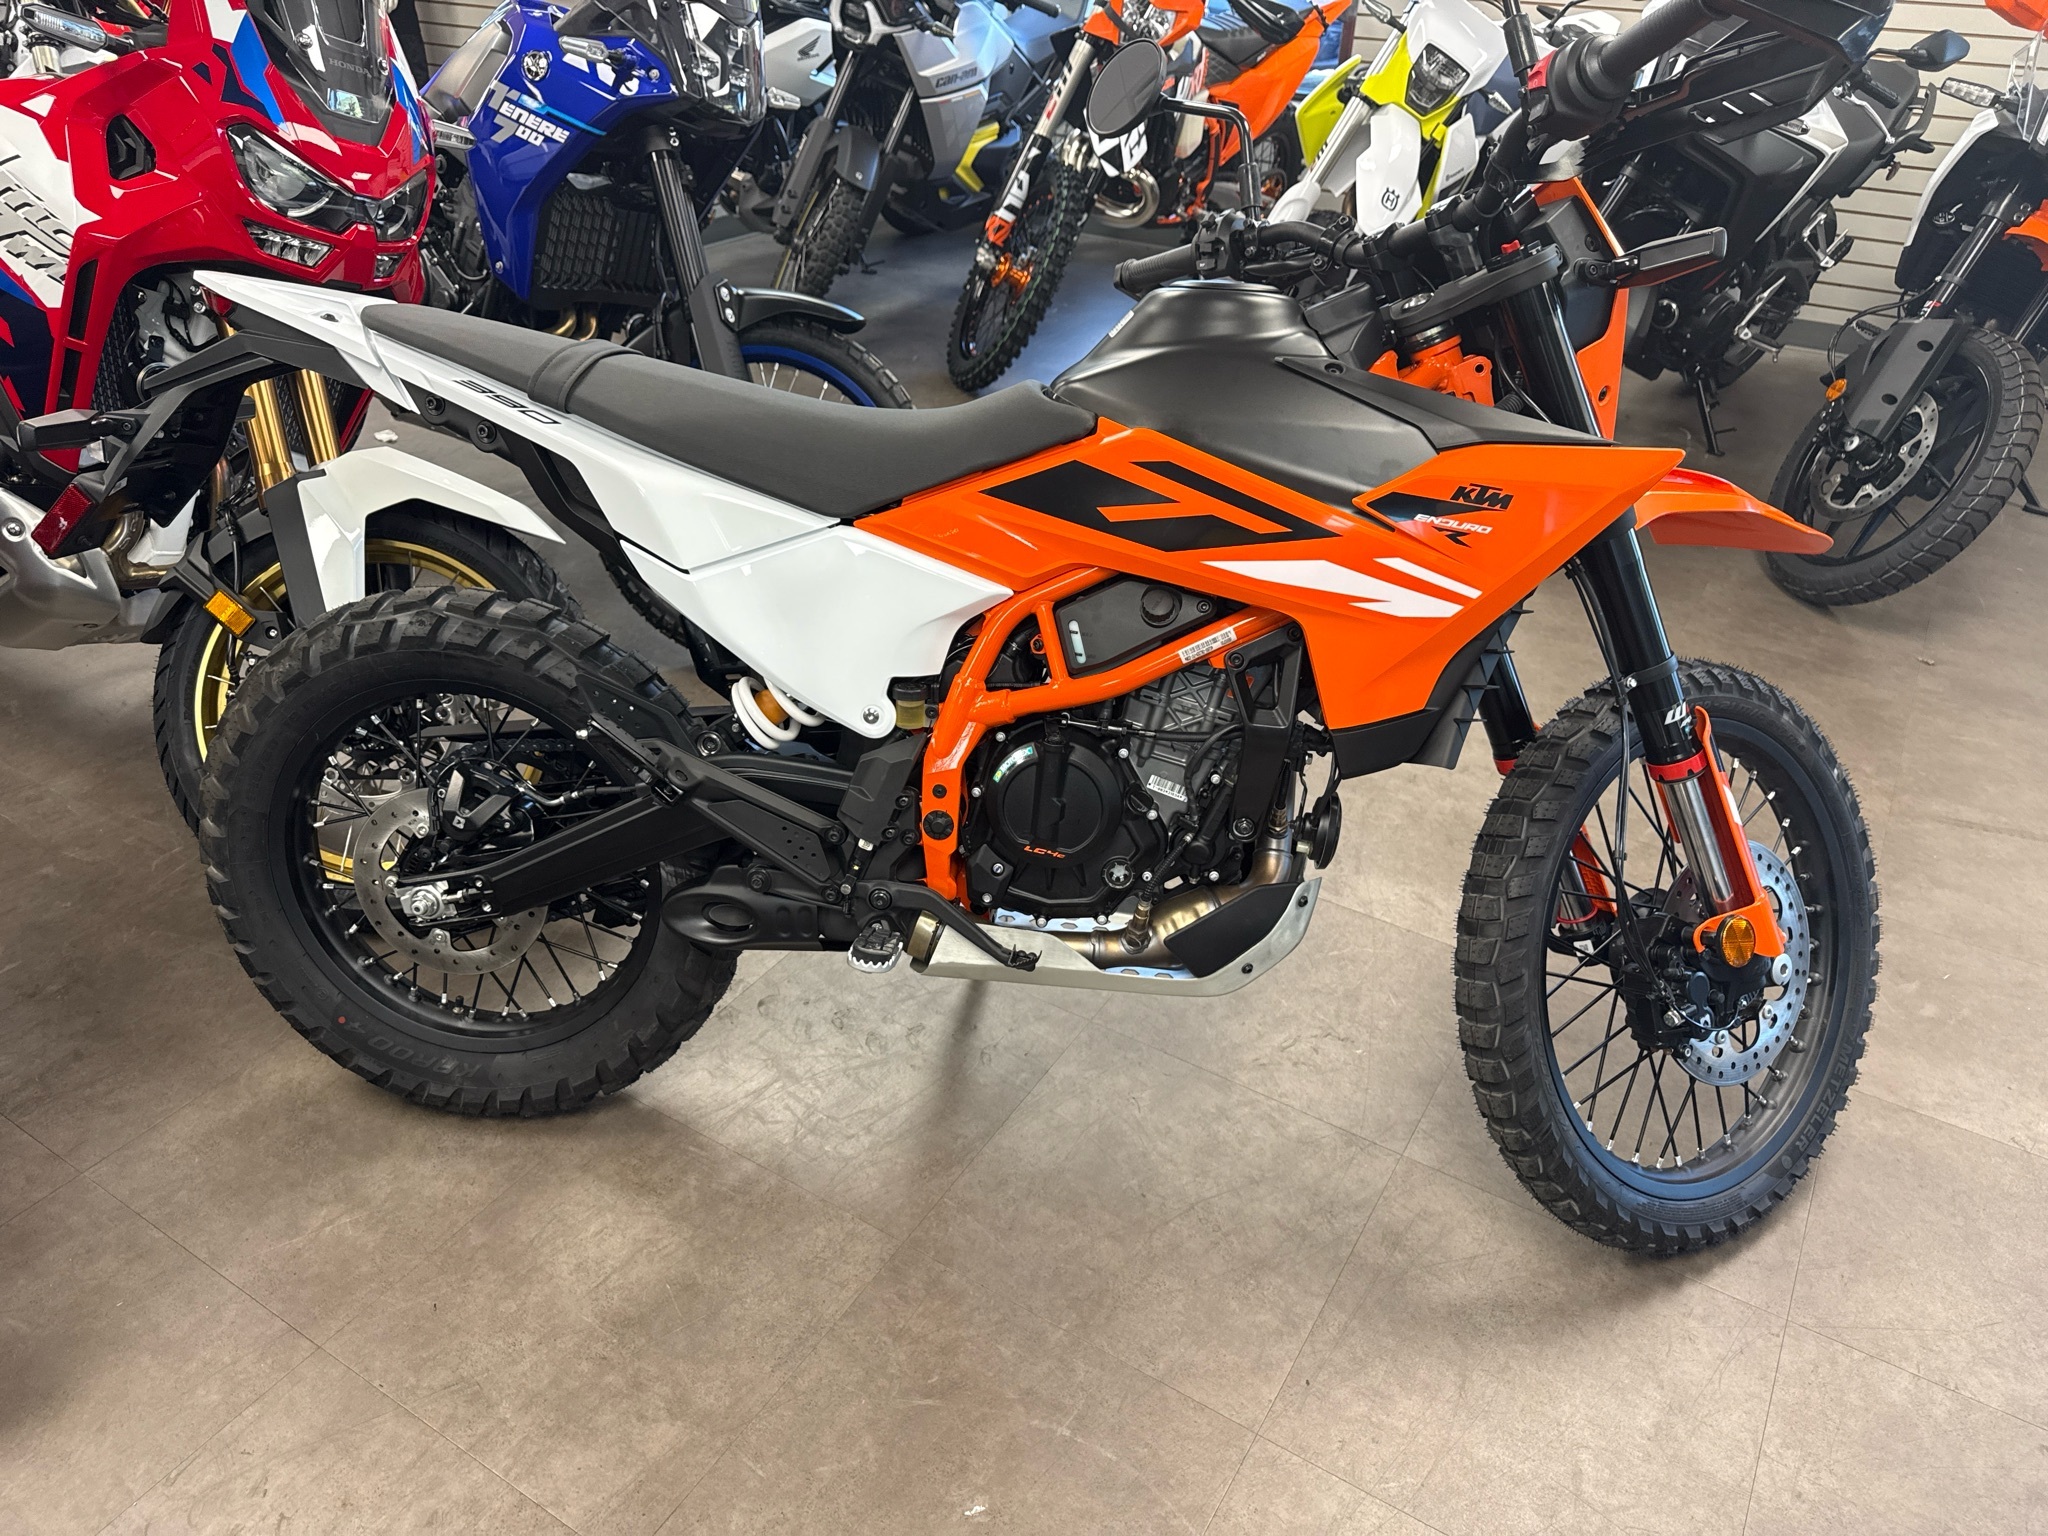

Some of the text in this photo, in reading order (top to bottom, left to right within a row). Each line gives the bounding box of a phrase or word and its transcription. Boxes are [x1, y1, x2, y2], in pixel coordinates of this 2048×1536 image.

[327, 57, 373, 79] HONDA
[490, 113, 545, 147] 700
[452, 379, 562, 425] 390
[1450, 482, 1515, 511] KTM
[1413, 512, 1494, 535] ENDURO
[1795, 1042, 1854, 1152] METZELER
